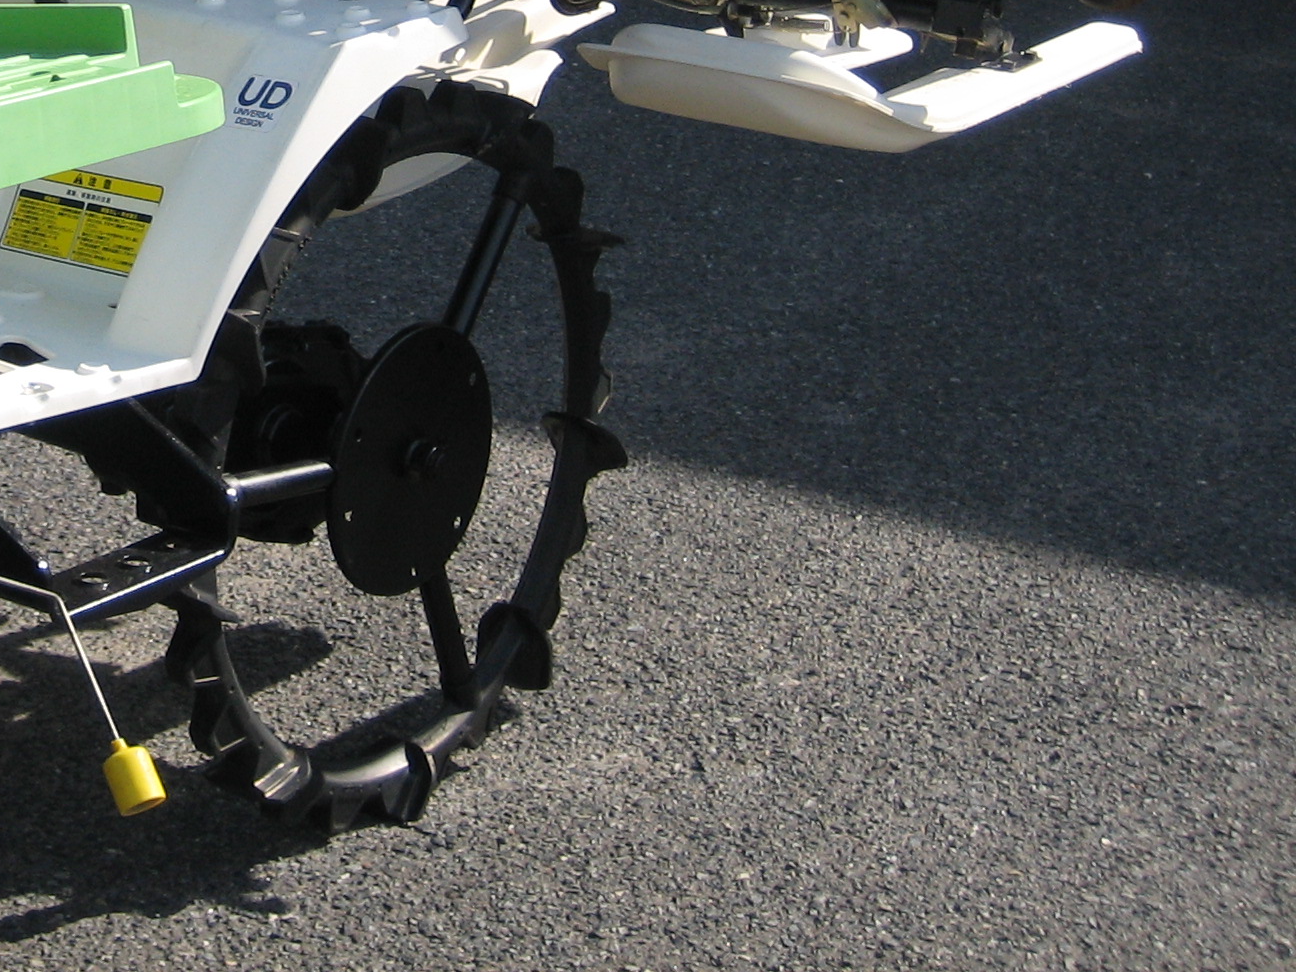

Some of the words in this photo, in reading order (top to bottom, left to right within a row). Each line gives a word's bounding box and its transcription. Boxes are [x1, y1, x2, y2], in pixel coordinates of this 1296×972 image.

[237, 76, 294, 111] UD
[233, 107, 275, 122] UNIVERSAL
[234, 116, 265, 128] DESIGN
